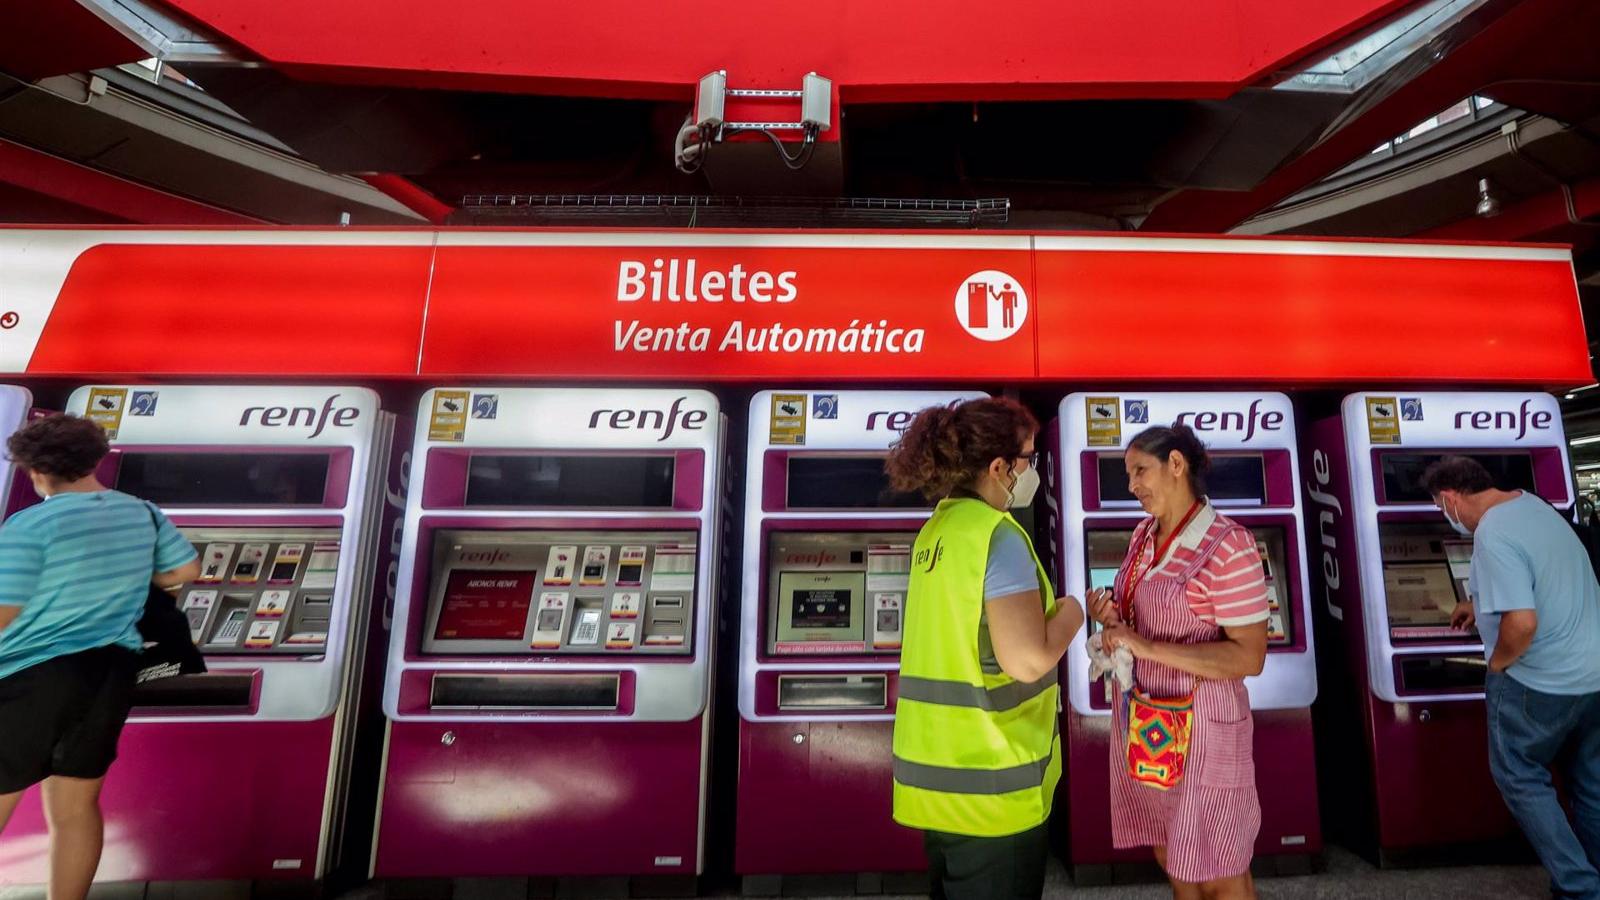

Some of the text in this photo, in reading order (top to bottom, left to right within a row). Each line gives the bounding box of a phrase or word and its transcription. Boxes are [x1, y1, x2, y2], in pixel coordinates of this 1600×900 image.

[617, 258, 798, 303] Billetes
[613, 319, 925, 353] Venta Automática
[239, 394, 360, 439] renfe
[588, 397, 708, 442] renfe
[1173, 398, 1284, 442] renfe
[1454, 399, 1552, 441] renfe
[460, 548, 512, 565] renfe
[915, 535, 944, 574] renfe
[1307, 449, 1343, 621] renfe
[784, 549, 837, 567] renfe
